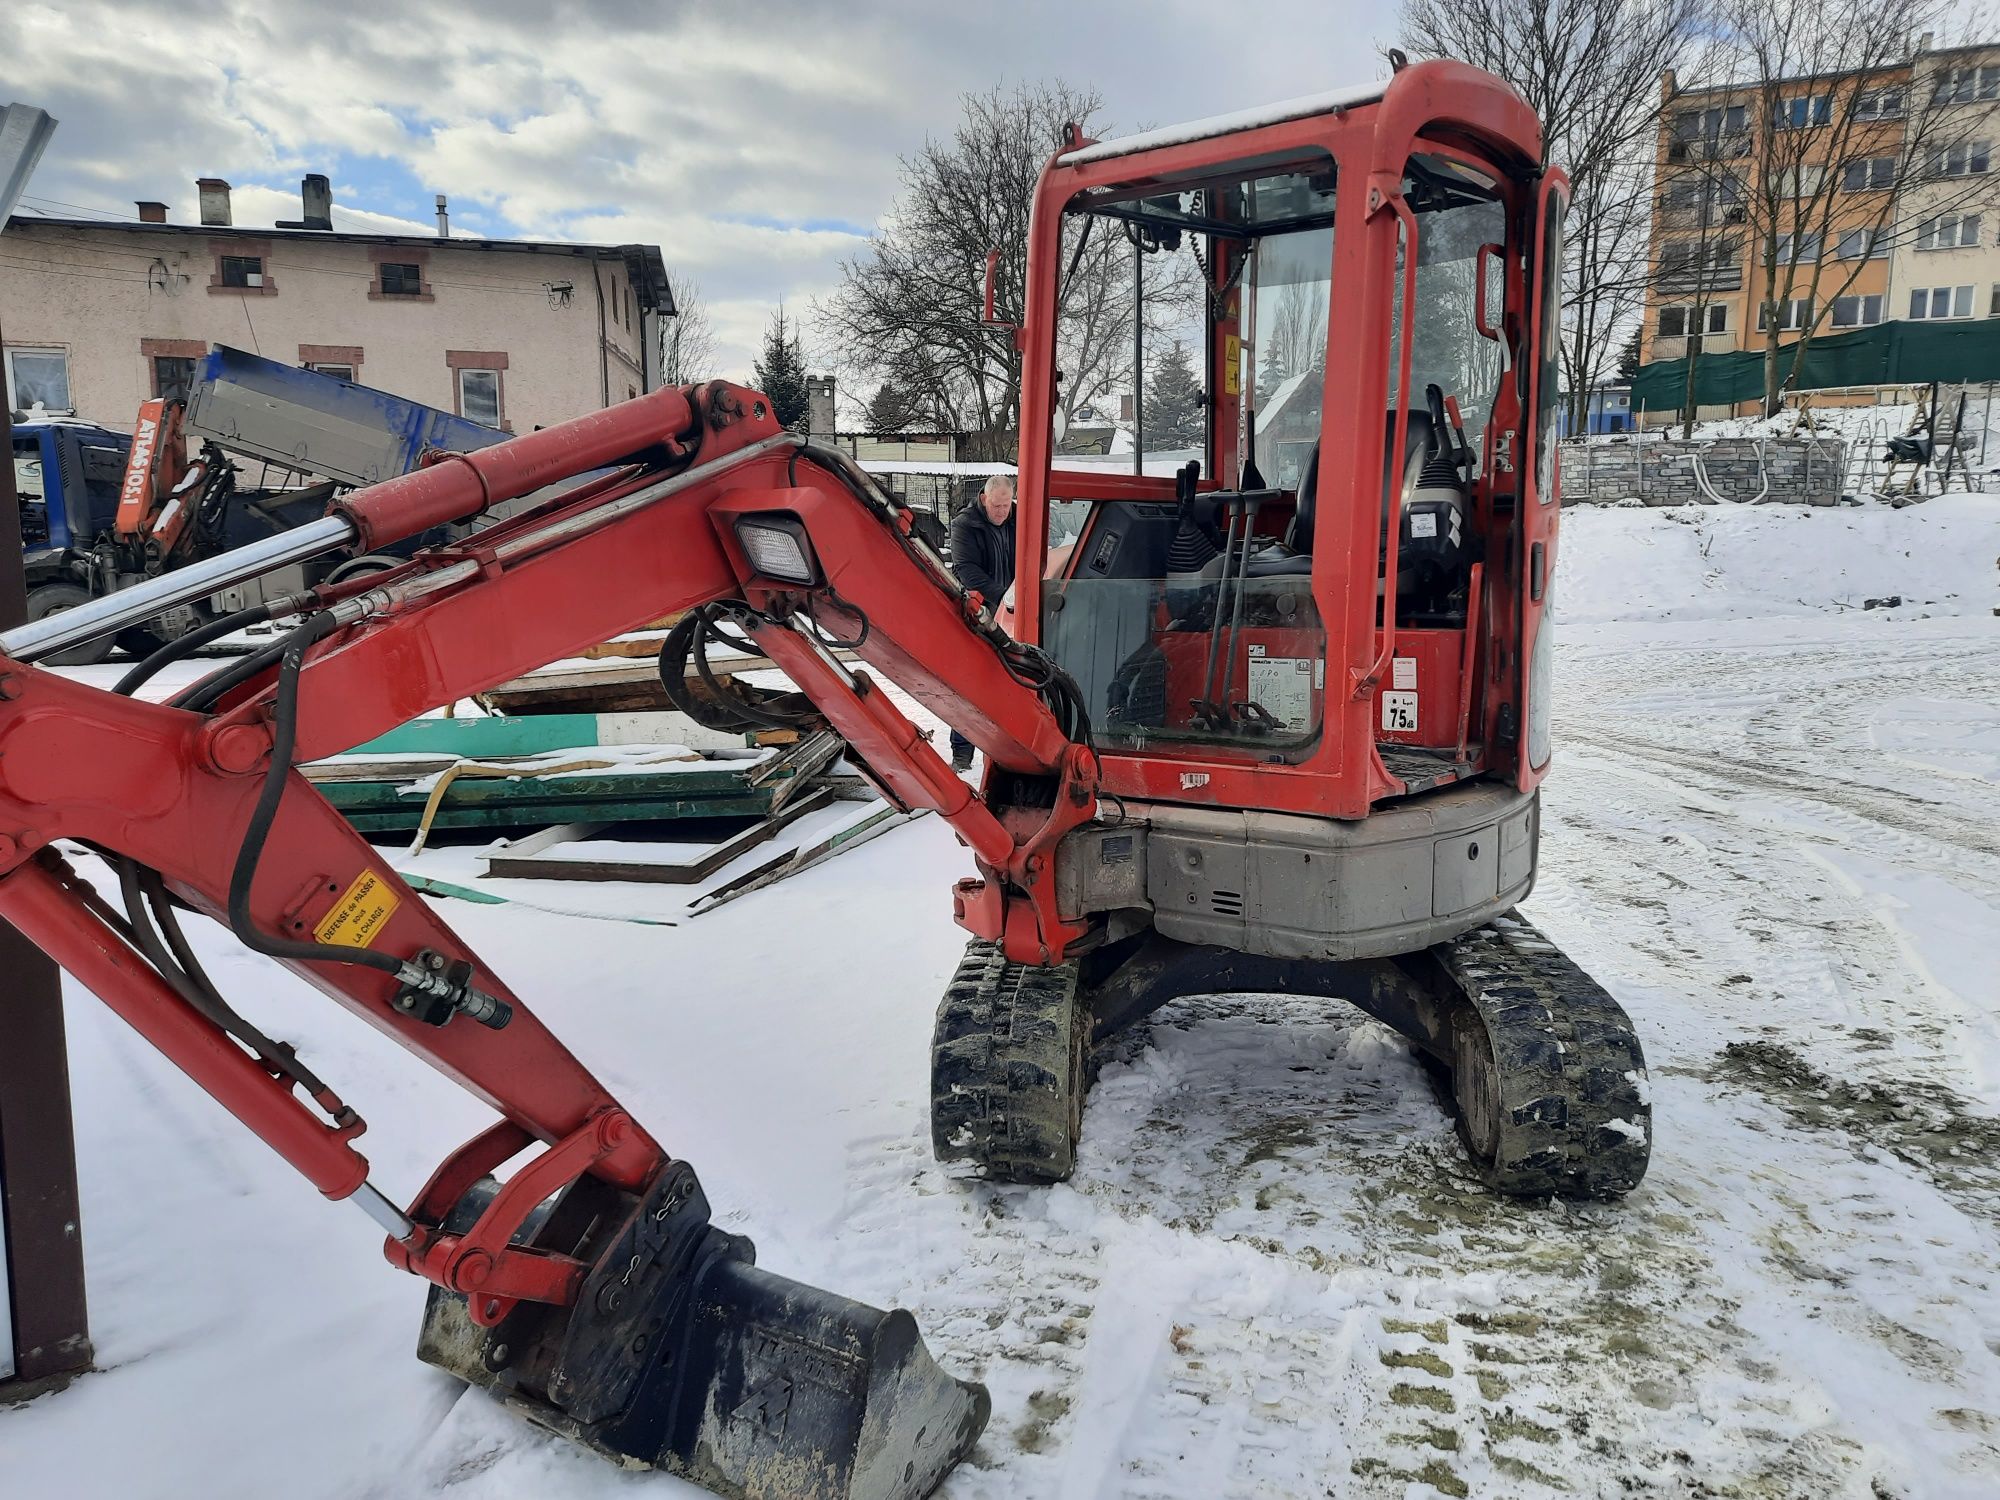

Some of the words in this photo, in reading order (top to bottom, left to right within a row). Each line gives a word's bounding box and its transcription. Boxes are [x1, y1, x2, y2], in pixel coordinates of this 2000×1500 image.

[132, 419, 156, 468] ATLAS
[123, 468, 144, 505] 105.1
[323, 910, 350, 940] DEFENSE
[348, 902, 357, 912] de
[354, 878, 376, 903] PASSER
[353, 933, 363, 944] LA
[360, 906, 384, 934] CHARGE
